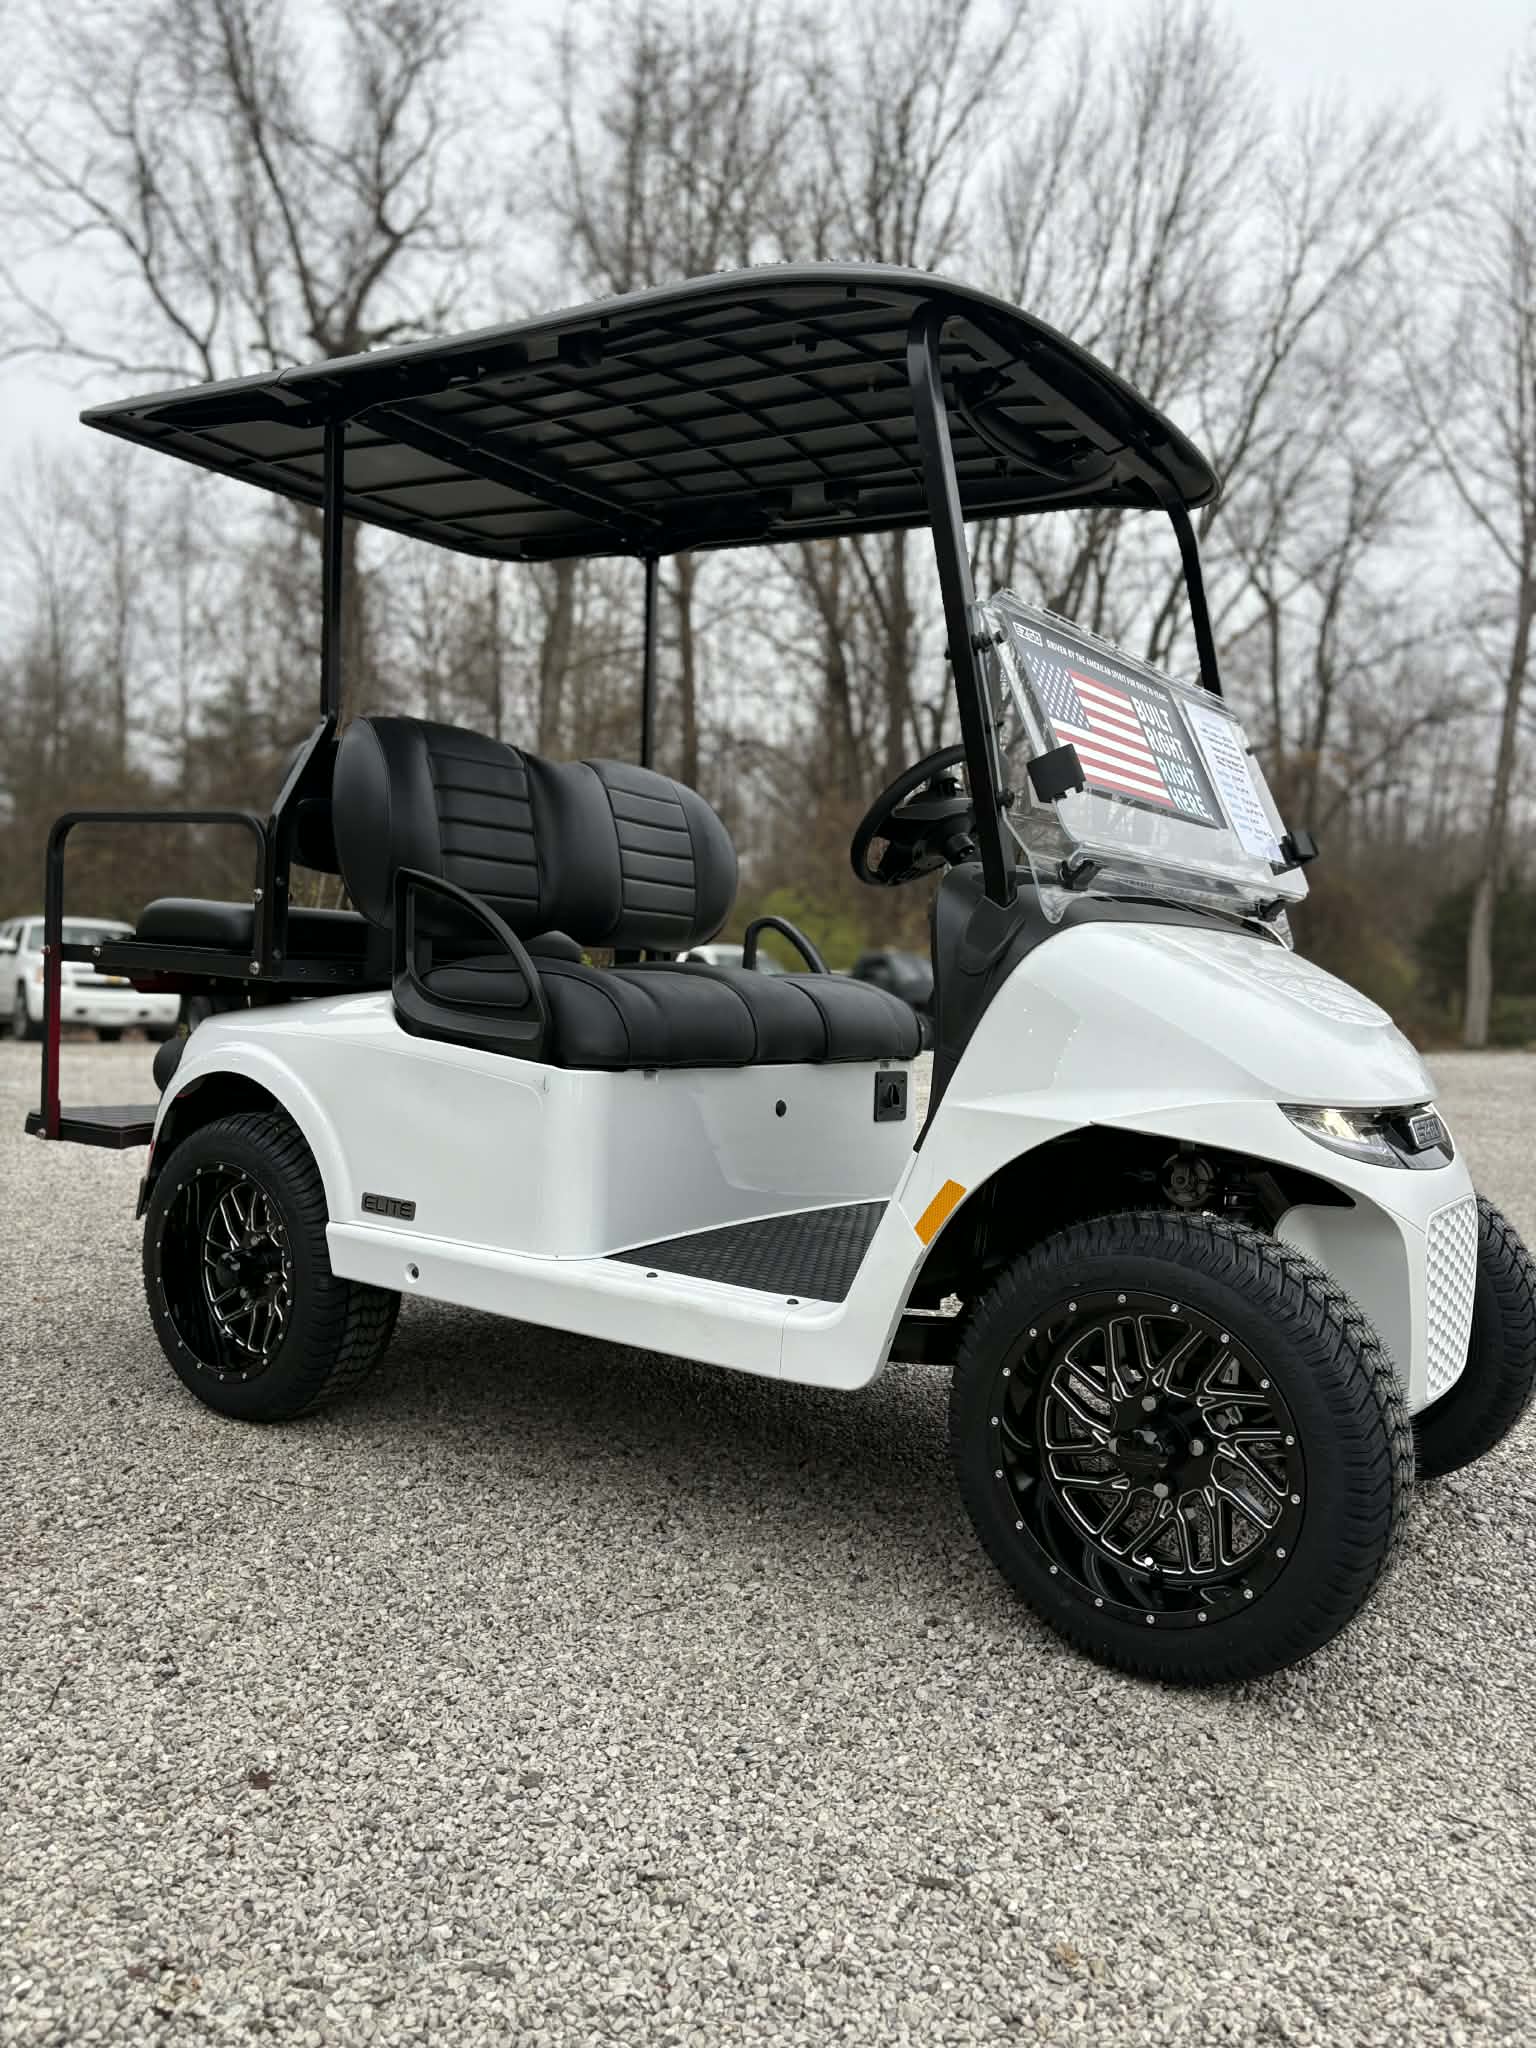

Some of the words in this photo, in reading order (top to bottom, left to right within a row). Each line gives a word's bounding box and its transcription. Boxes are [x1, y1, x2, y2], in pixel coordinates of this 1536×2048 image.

[1075, 652, 1086, 665] THE
[1131, 695, 1173, 734] BUILT
[1142, 724, 1192, 764] RIGHT.
[1155, 755, 1200, 793] RIGHT
[1167, 785, 1215, 821] HERE.
[364, 1195, 412, 1218] ELITE
